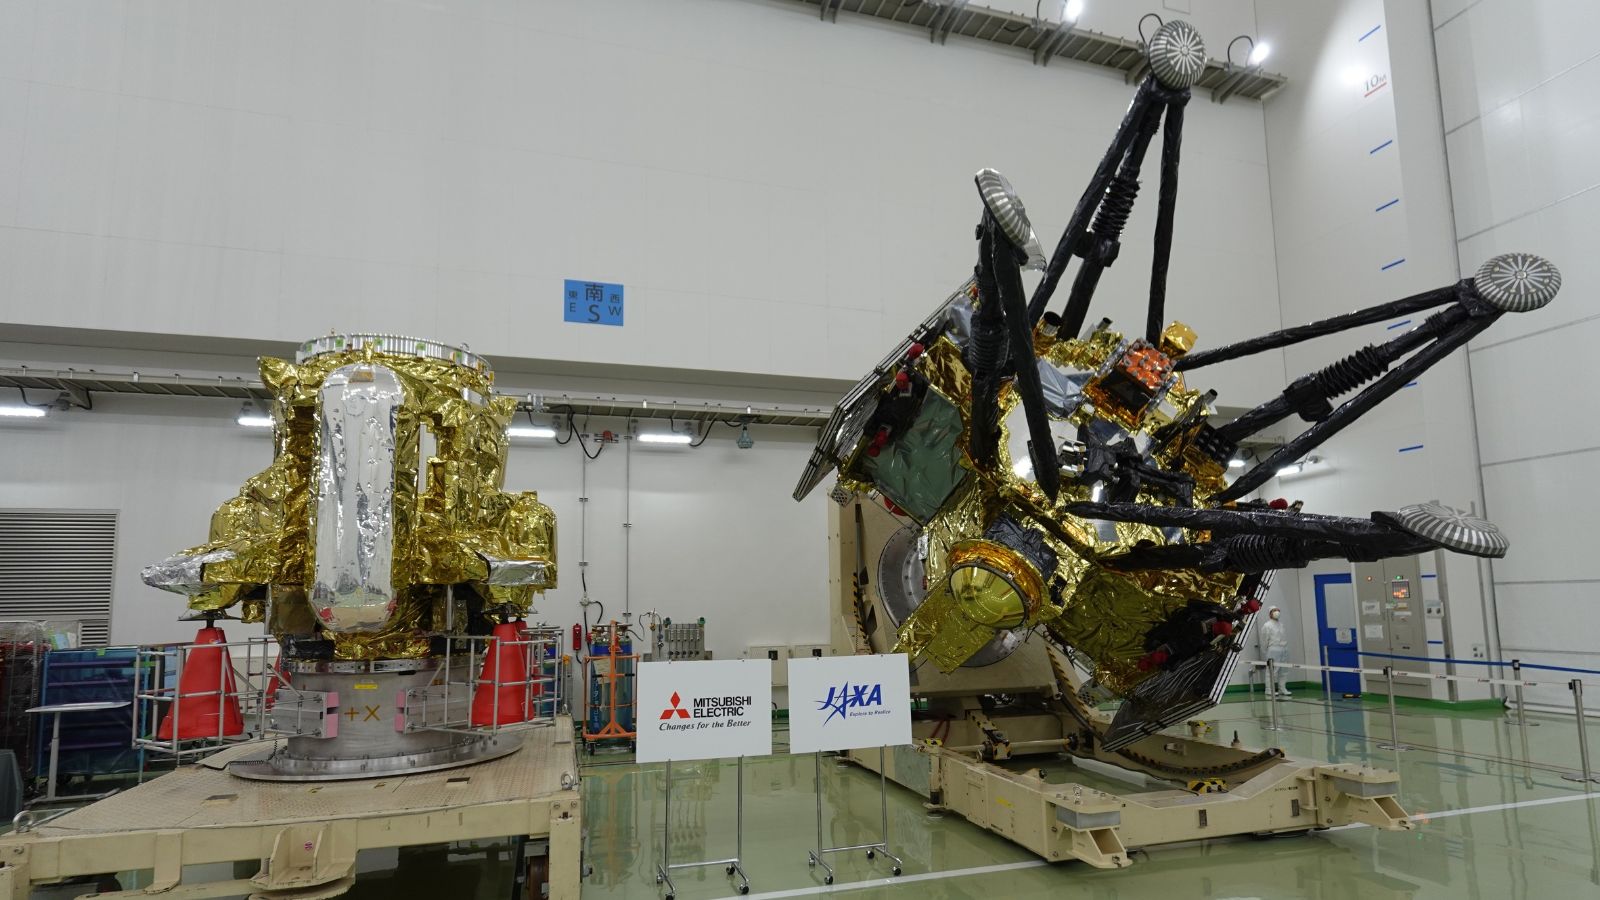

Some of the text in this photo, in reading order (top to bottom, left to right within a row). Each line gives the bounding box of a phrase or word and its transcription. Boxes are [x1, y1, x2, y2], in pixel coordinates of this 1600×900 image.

[584, 283, 604, 301] 南
[569, 302, 576, 312] E
[608, 306, 621, 316] W
[588, 304, 600, 322] S
[693, 696, 751, 707] MITSUBISHI
[815, 681, 882, 724] JAXA
[693, 707, 744, 718] ELECTRIC
[659, 719, 751, 731] Changes for the Better
